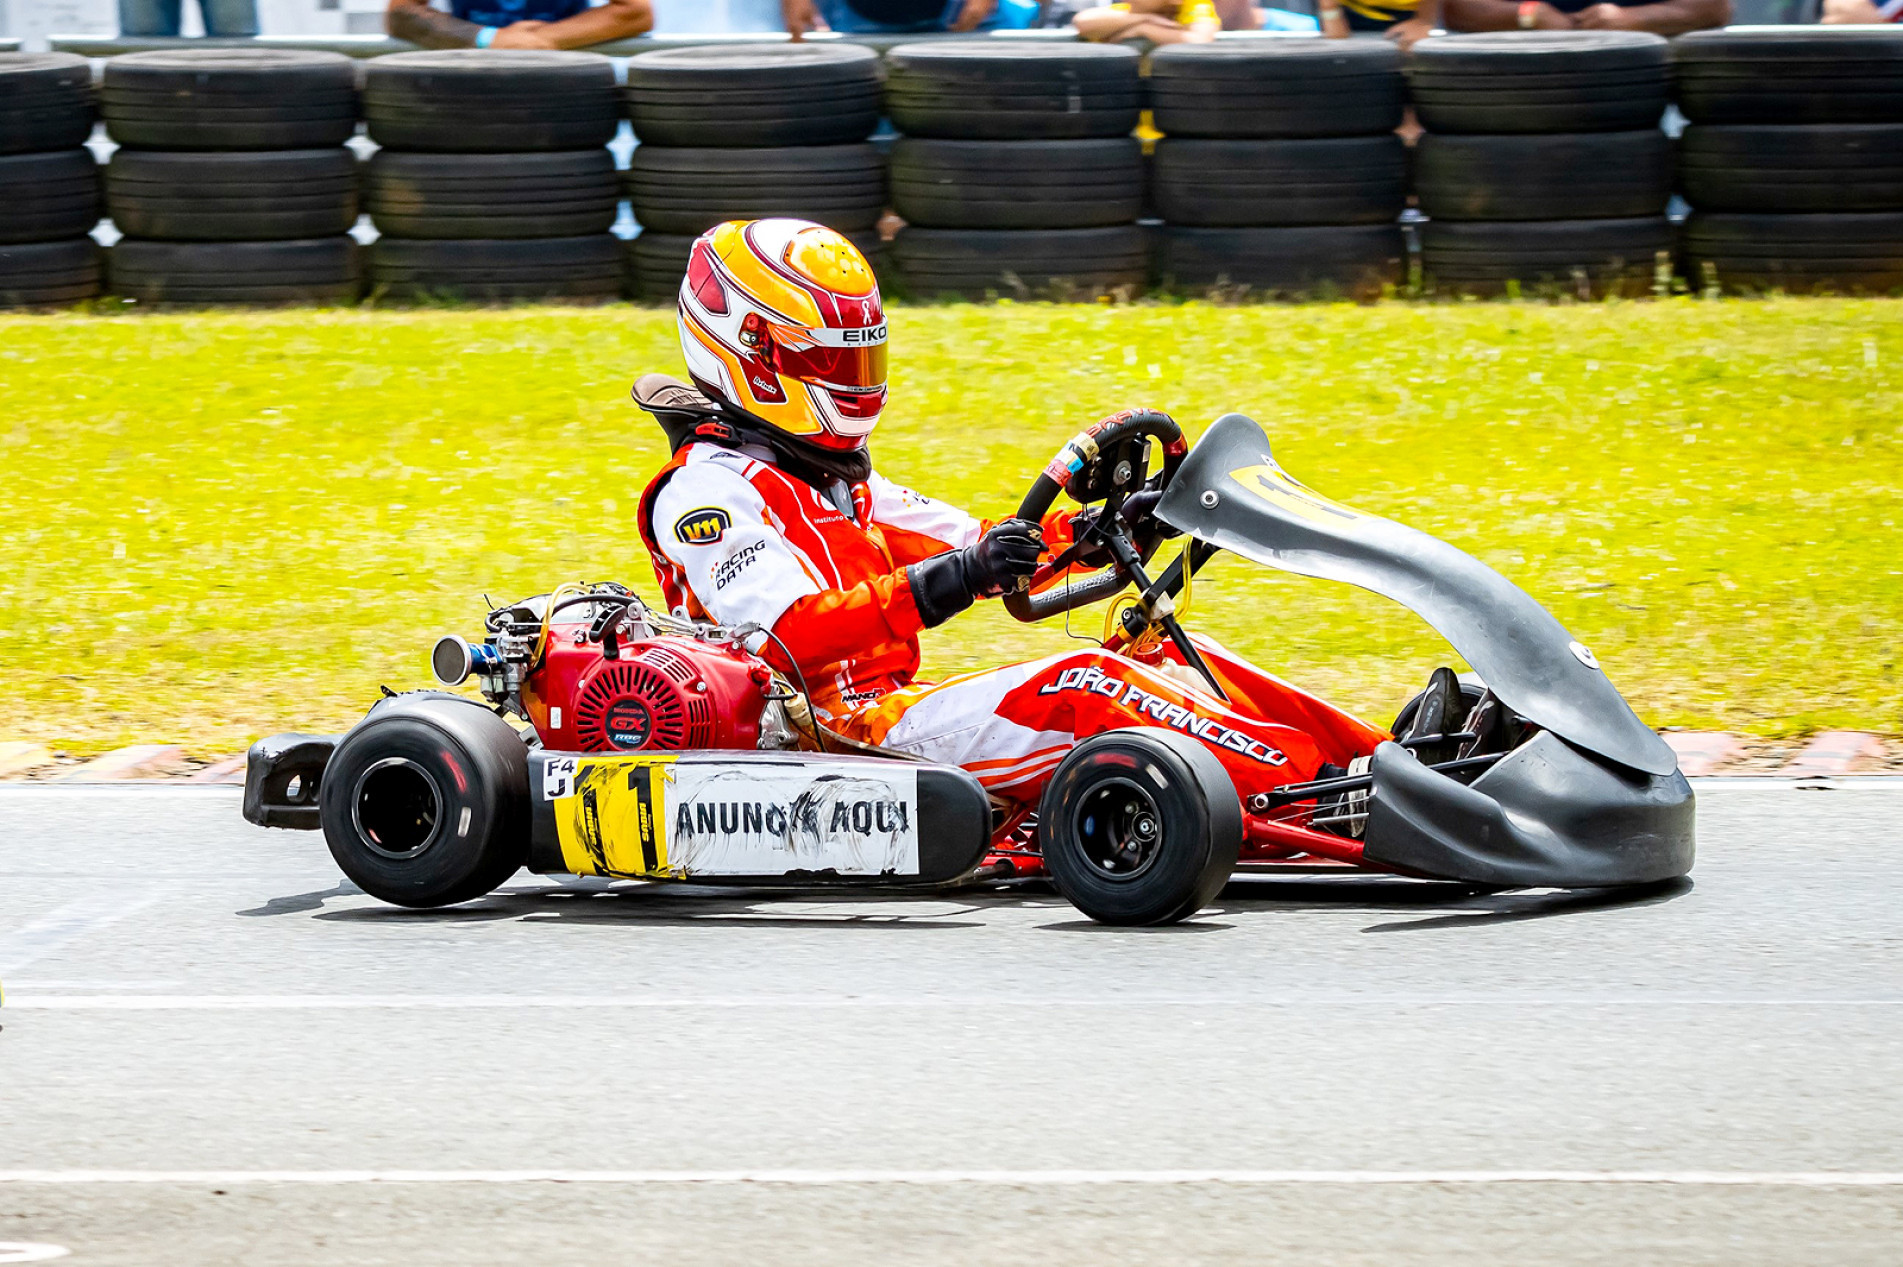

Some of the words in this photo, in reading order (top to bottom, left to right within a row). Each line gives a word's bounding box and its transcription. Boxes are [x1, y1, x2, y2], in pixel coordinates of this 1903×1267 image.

[716, 555, 757, 591] DATA
[611, 716, 646, 731] GX
[1037, 665, 1125, 698] JOÃO
[1118, 683, 1289, 767] FRANCISCO
[547, 760, 575, 777] F4
[547, 778, 566, 797] J
